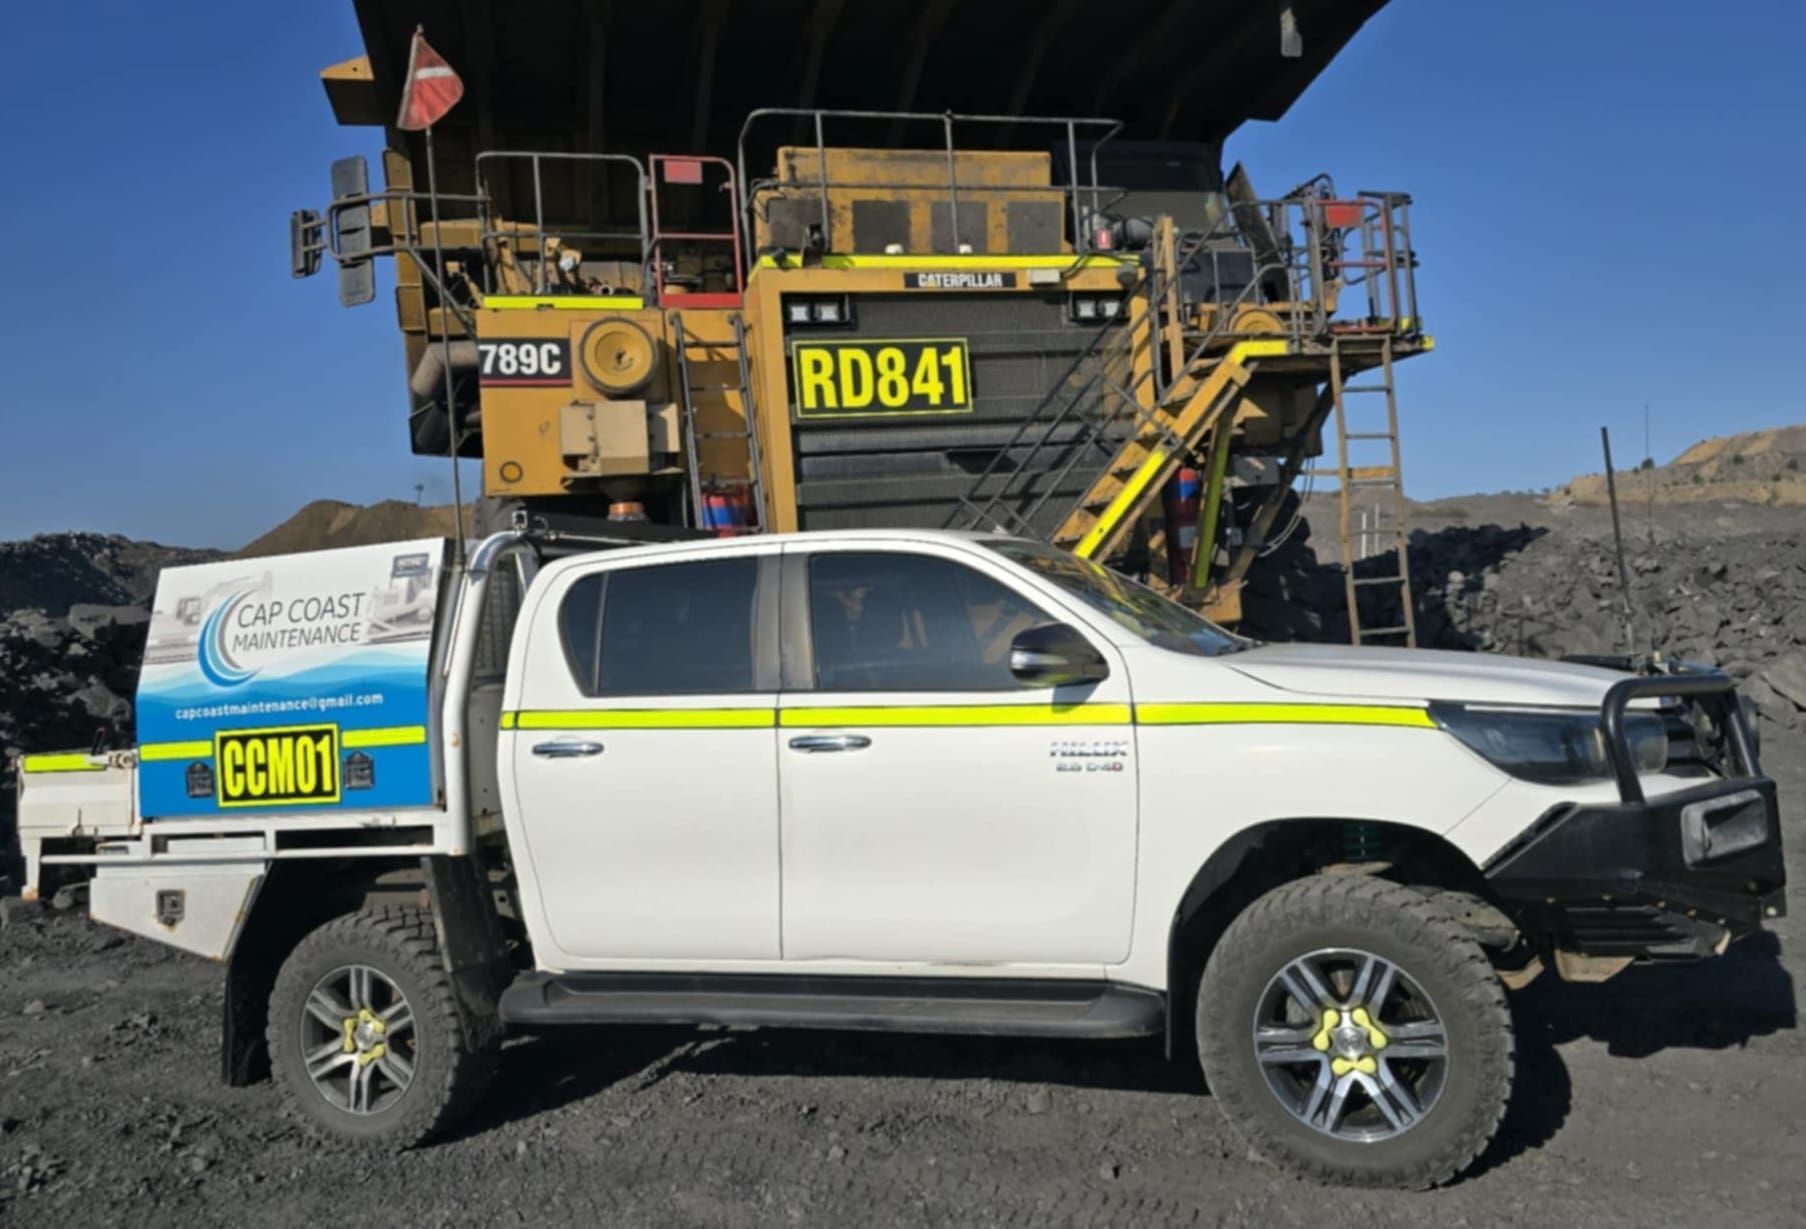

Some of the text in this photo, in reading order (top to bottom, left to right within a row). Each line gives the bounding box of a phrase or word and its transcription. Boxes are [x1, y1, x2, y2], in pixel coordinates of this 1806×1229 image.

[918, 273, 1003, 288] CATERPILLAR
[477, 343, 562, 375] 789C
[800, 346, 966, 409] RD841
[238, 592, 366, 628] CAP COAST
[232, 622, 362, 653] MAINTENANCE
[175, 692, 384, 720] capcoastmaintenance@gmail.com
[1050, 741, 1128, 757] HILUX
[223, 735, 333, 797] CCM01
